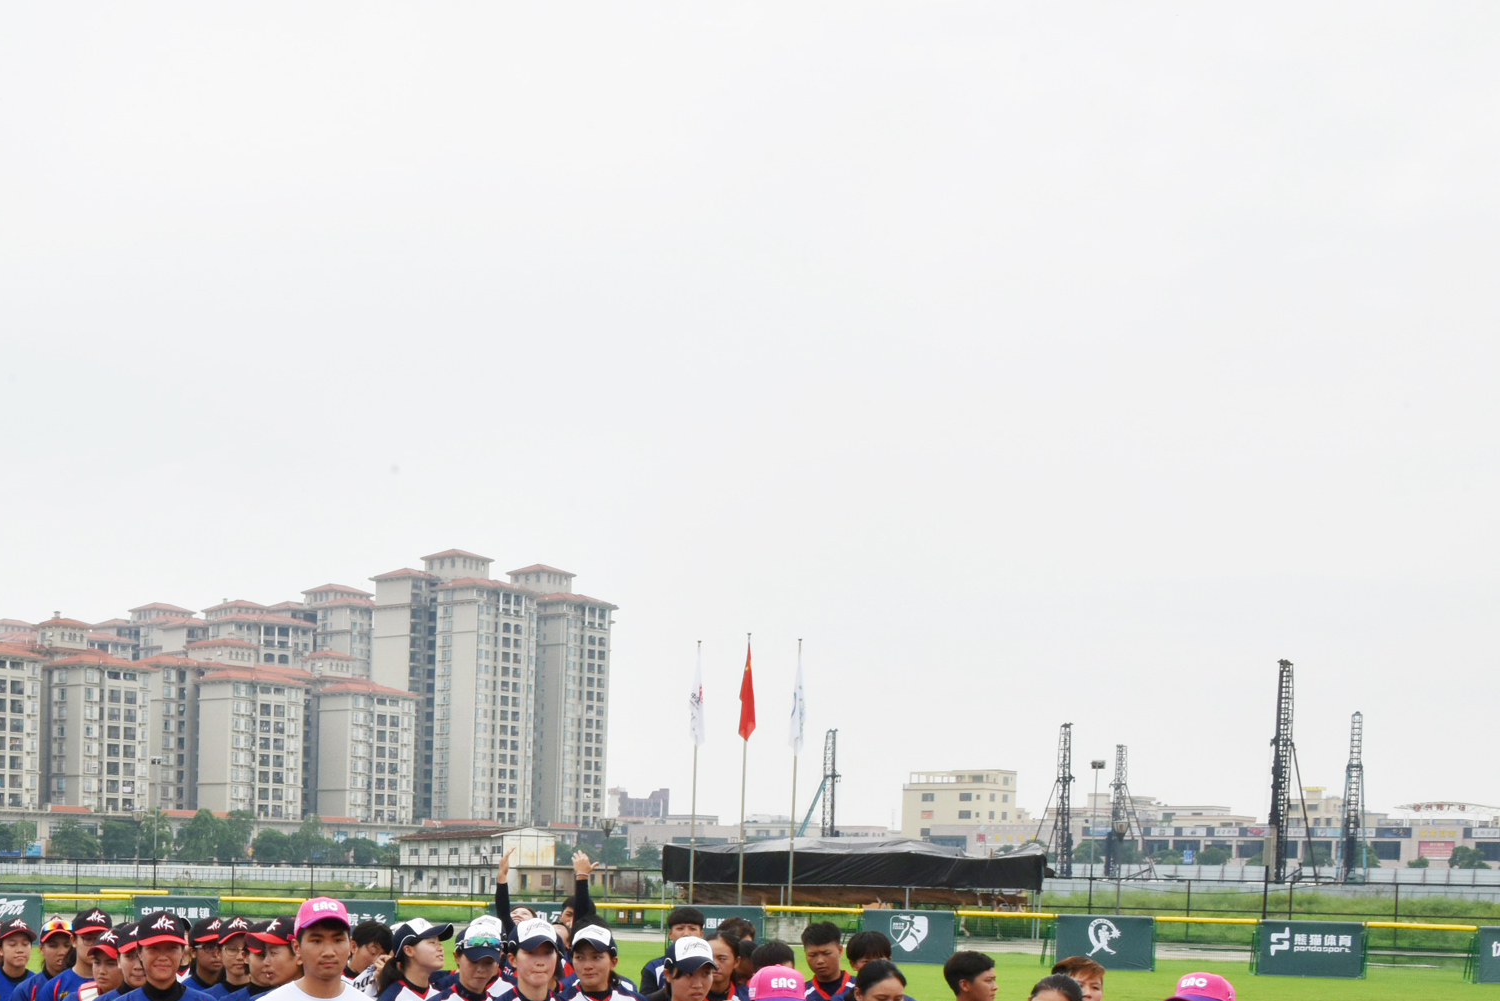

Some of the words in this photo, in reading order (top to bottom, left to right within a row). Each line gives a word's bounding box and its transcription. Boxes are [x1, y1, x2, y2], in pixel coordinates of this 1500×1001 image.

[312, 902, 338, 911] EAC
[86, 910, 107, 924] HK
[150, 914, 176, 931] HK
[228, 916, 248, 930] HK
[100, 929, 119, 944] HK
[1294, 934, 1352, 946] 熊猫体育
[770, 977, 798, 989] EAC
[1180, 977, 1208, 988] EAC
